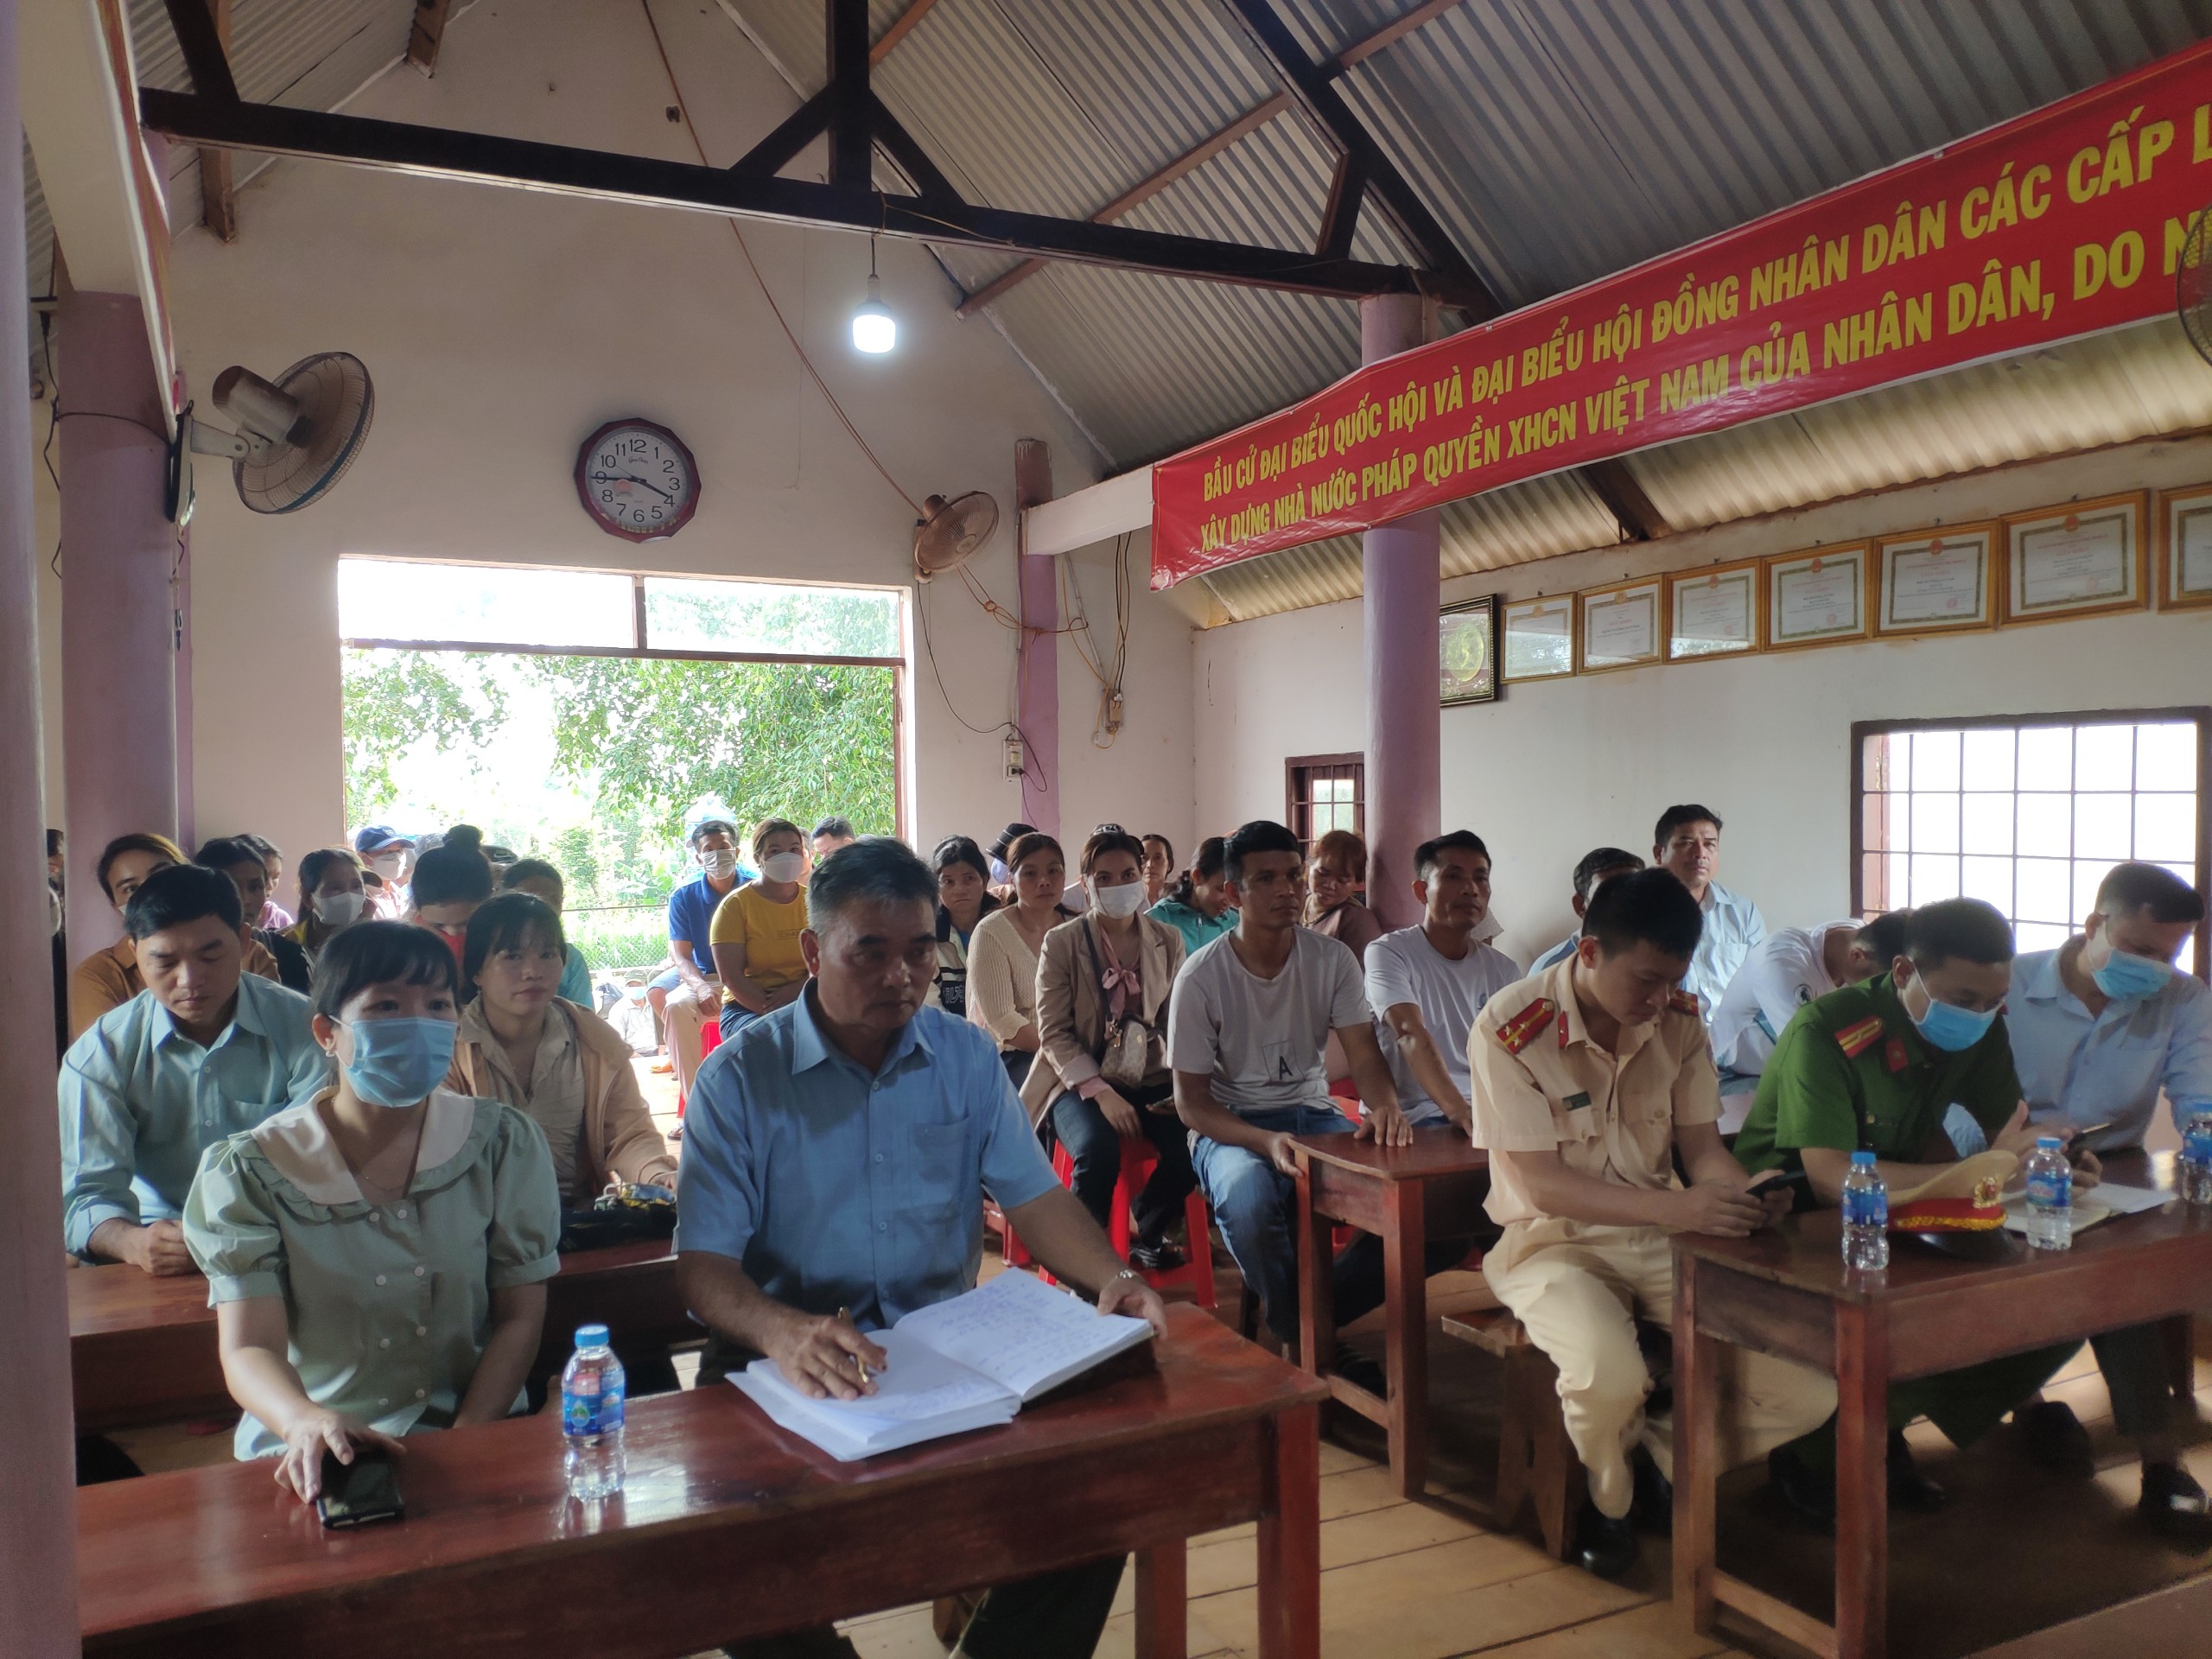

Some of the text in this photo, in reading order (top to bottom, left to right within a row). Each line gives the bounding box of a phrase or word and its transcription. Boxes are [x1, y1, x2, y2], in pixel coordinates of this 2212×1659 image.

[1204, 456, 1232, 502] BẦU
[1236, 443, 1257, 489] CỬ
[1260, 442, 1287, 481] ĐẠI
[1291, 412, 1329, 469] BIỂU
[1333, 392, 1382, 455] QUỐC
[1389, 381, 1426, 432] HỘI
[1433, 365, 1463, 416] VÀ
[1471, 354, 1514, 404] ĐẠI
[1522, 316, 1584, 387] BIỂU
[1592, 303, 1643, 363] HỘI
[1651, 272, 1739, 344] ĐỒNG
[1750, 234, 1849, 311] NHÂN
[1862, 200, 1946, 274] DÂN
[1960, 162, 2052, 239] CÁC
[2067, 105, 2175, 204] CẤP
[1201, 206, 2212, 553] XÂY DỰNG NHÀ NƯỚC PHÁP QUYỀN XHCN VIỆT NAM CỦA NHÂN DÂN, DO N
[615, 443, 626, 456] 11
[629, 439, 646, 453] 12
[654, 446, 659, 459] 1
[601, 454, 616, 467] 10
[662, 460, 675, 473] 2
[669, 477, 680, 490] 3
[601, 489, 613, 502] 8
[663, 494, 676, 507] 4
[616, 503, 626, 516] 7
[632, 509, 645, 522] 6
[651, 505, 663, 518] 5
[1279, 1056, 1294, 1080] A
